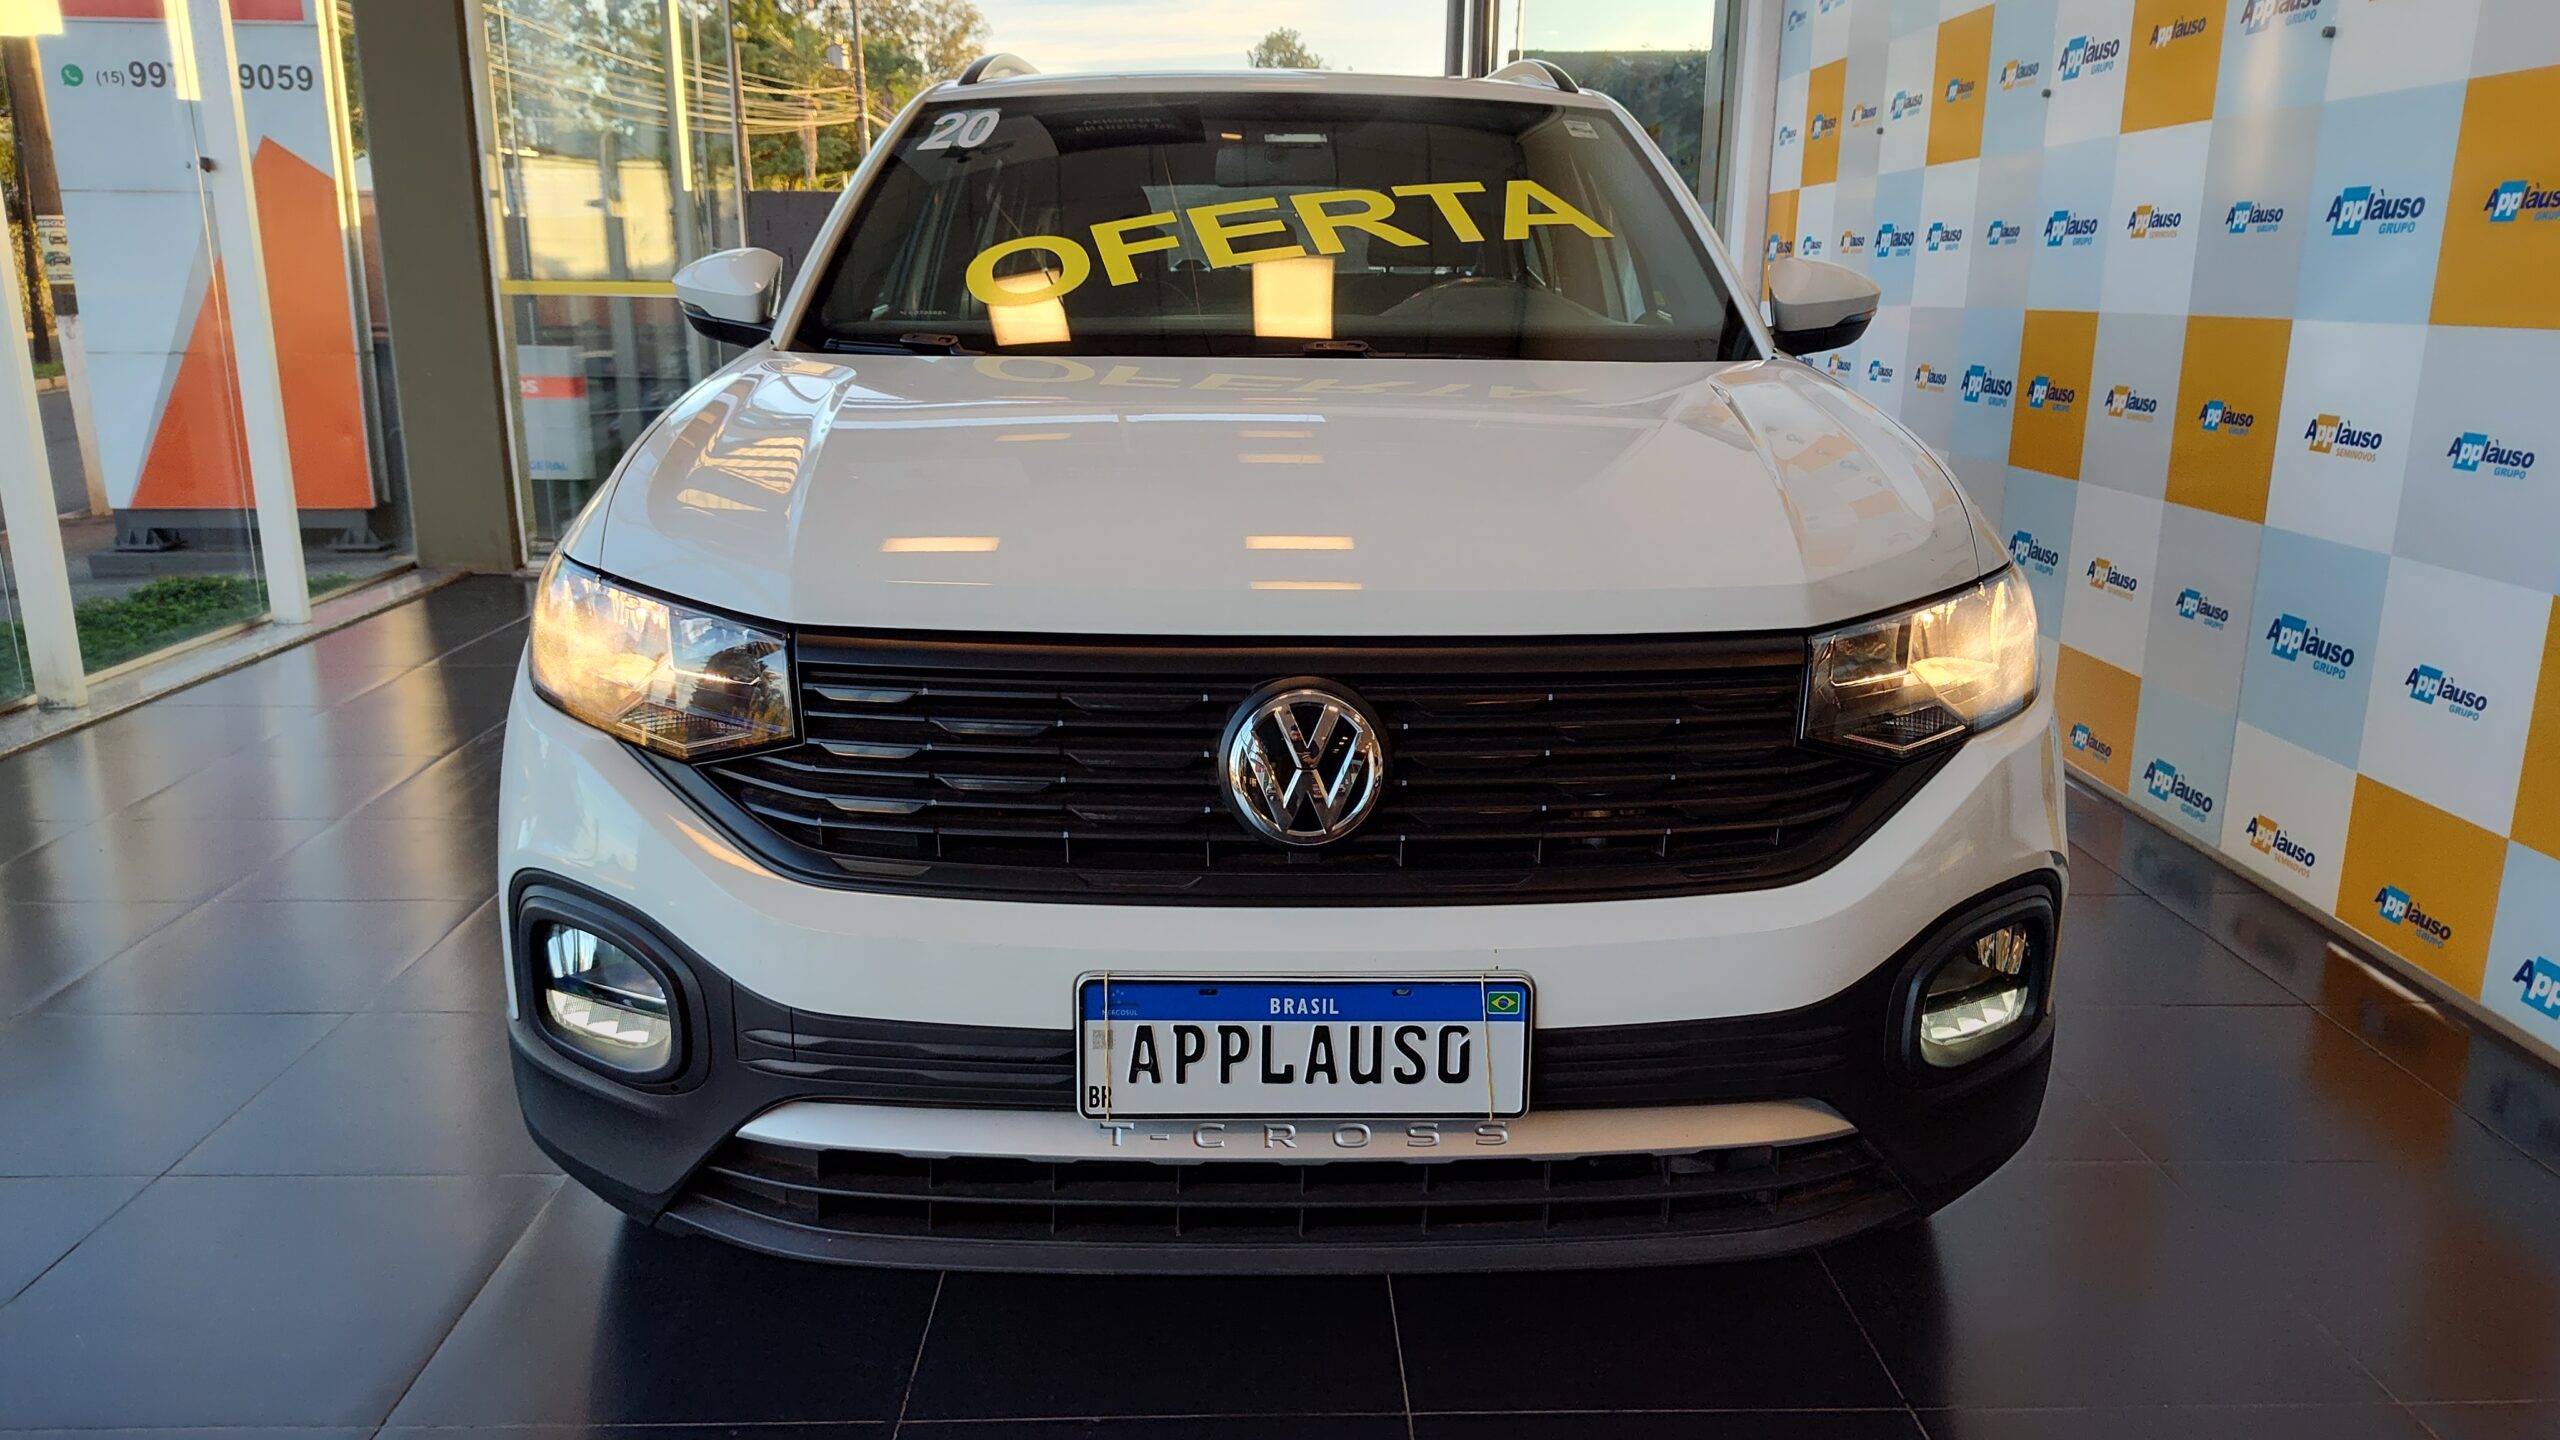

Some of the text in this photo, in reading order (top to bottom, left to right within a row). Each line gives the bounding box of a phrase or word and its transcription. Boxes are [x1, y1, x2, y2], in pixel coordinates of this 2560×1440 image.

[96, 70, 125, 86] (15)
[917, 111, 1000, 150] 20
[2378, 221, 2416, 235] GRUPO
[965, 179, 1614, 306] OFERTA
[2494, 466, 2527, 480] GRUPO
[2313, 660, 2346, 680] GRUPO
[2448, 703, 2480, 722] GRUPO
[1270, 998, 1339, 1015] BRASIL
[1089, 1085, 1112, 1108] BR
[1101, 1120, 1510, 1149] T-CROSS
